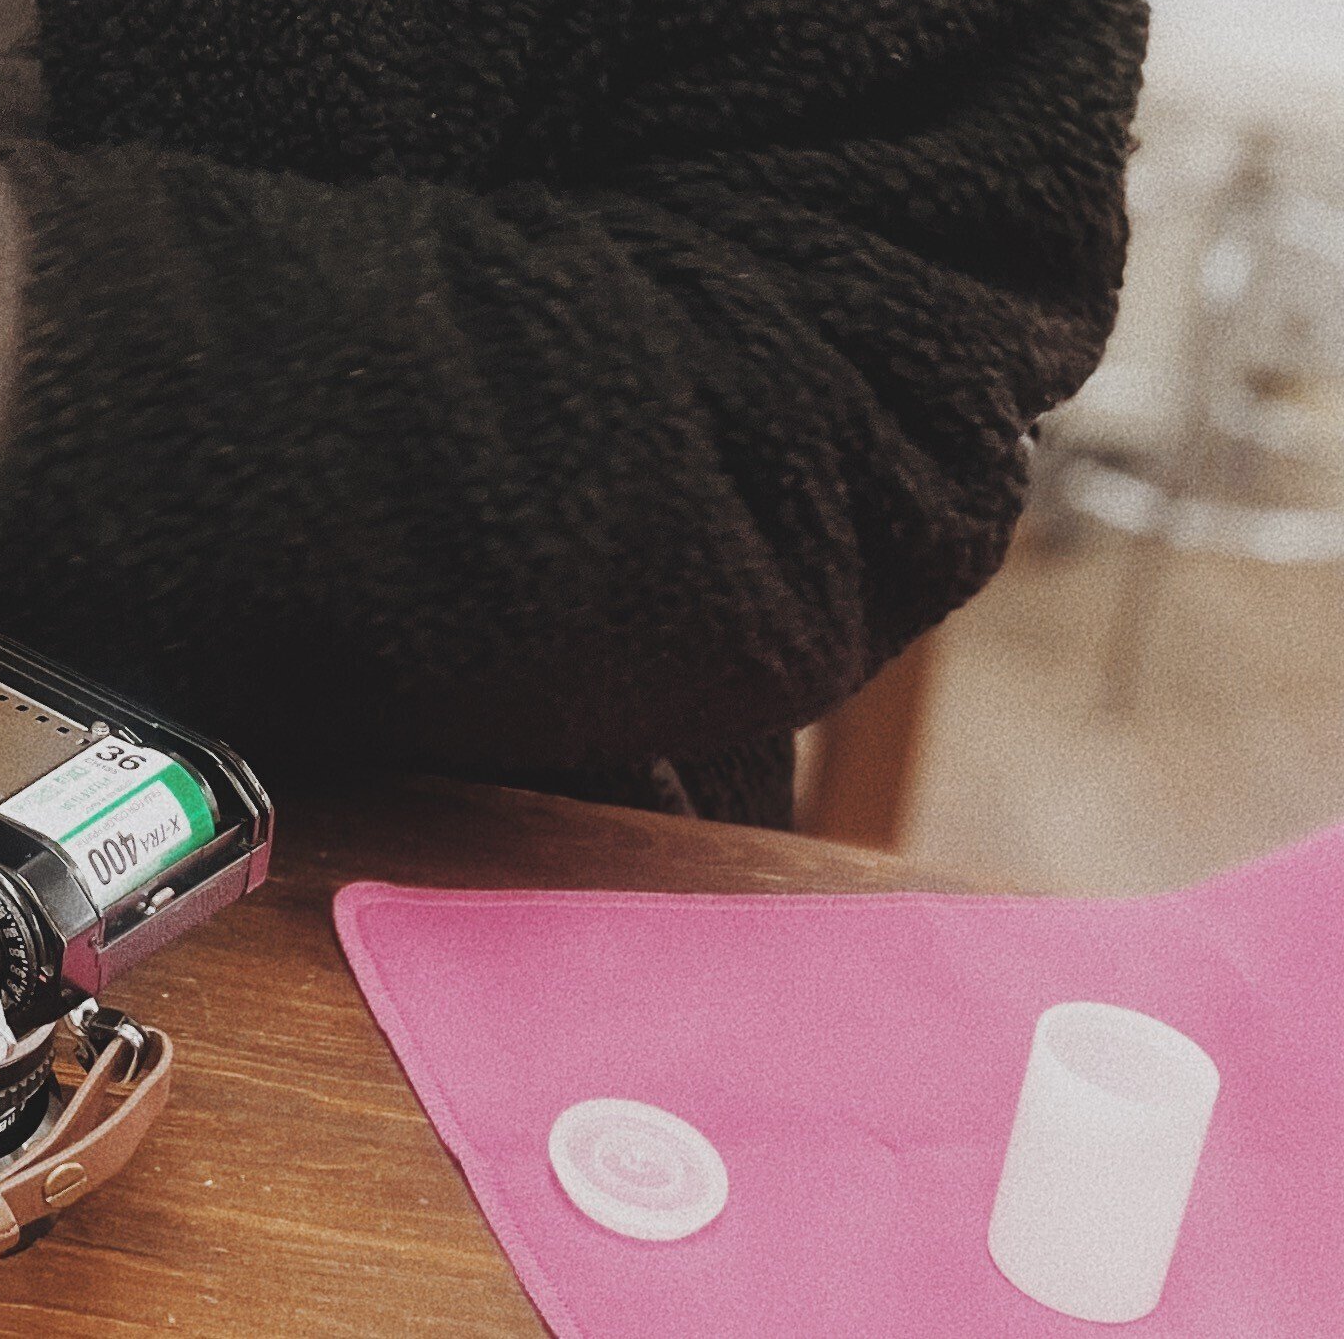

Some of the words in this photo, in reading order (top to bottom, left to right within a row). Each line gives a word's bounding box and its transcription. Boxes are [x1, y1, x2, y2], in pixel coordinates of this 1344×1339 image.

[95, 745, 147, 770] 36
[139, 813, 182, 853] X-TRA
[87, 831, 138, 885] 400
